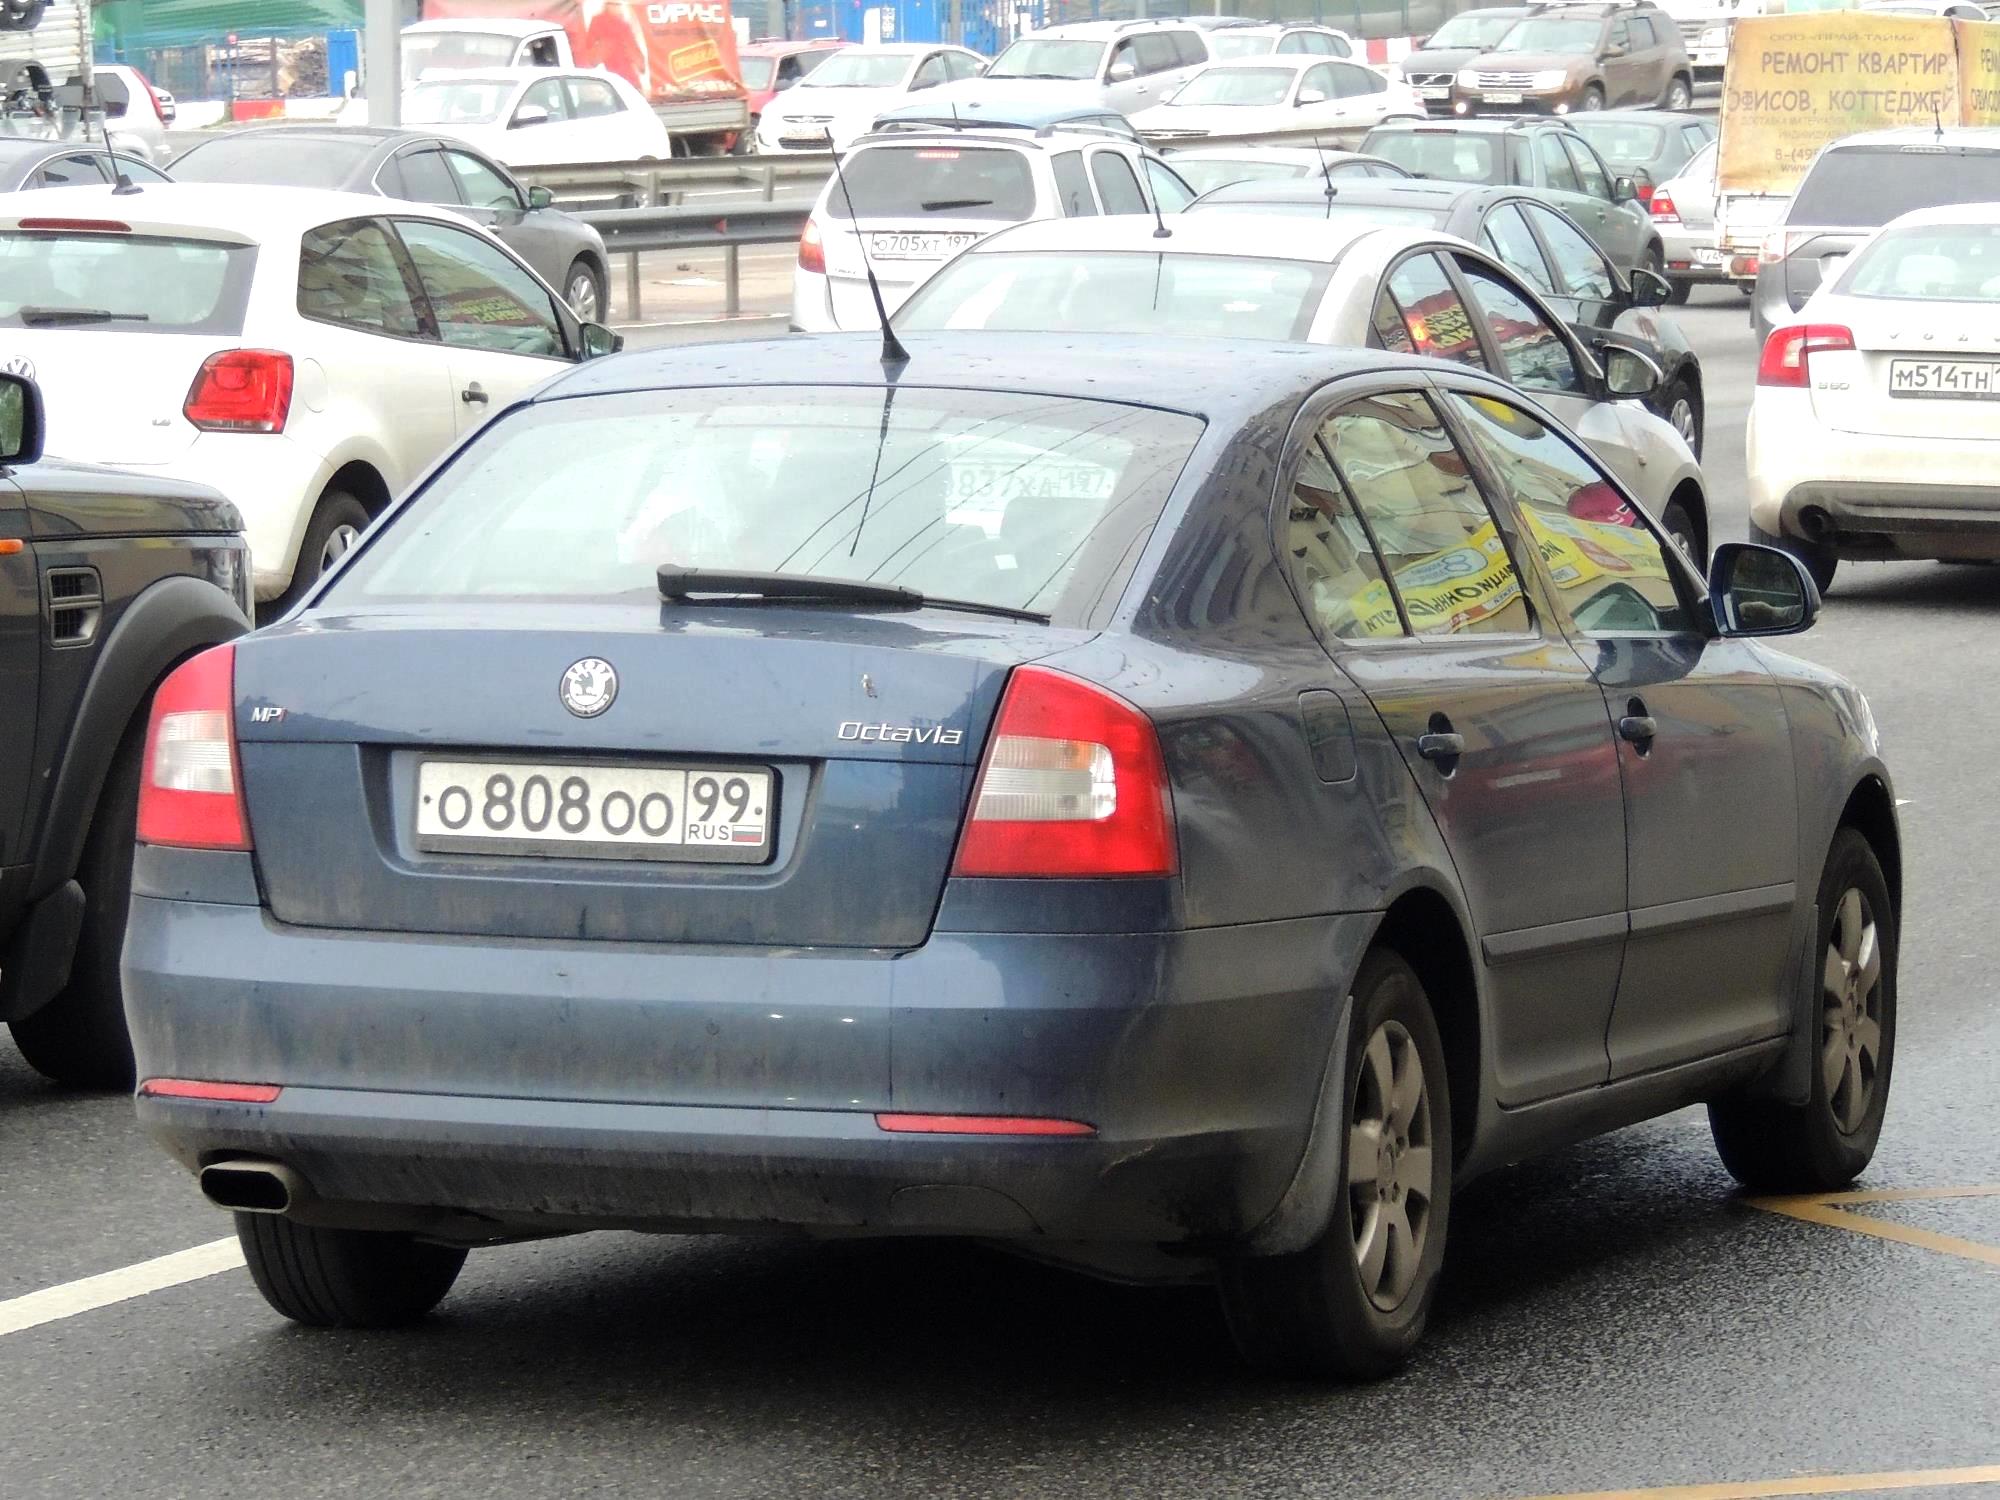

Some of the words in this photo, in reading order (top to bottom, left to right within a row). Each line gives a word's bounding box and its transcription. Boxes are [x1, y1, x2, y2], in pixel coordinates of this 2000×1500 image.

[1762, 51, 1849, 74] РЕМОНТ
[1858, 51, 1948, 75] КВАРТИР
[1829, 87, 1954, 116] КОТТЕДЖЕЙ
[877, 235, 940, 251] О705ХТ
[946, 235, 970, 248] 197
[1898, 365, 1989, 390] М514ТН
[838, 721, 963, 745] Octavia
[438, 772, 674, 838] О808ОО
[693, 776, 751, 823] 99
[688, 824, 729, 841] RUS
